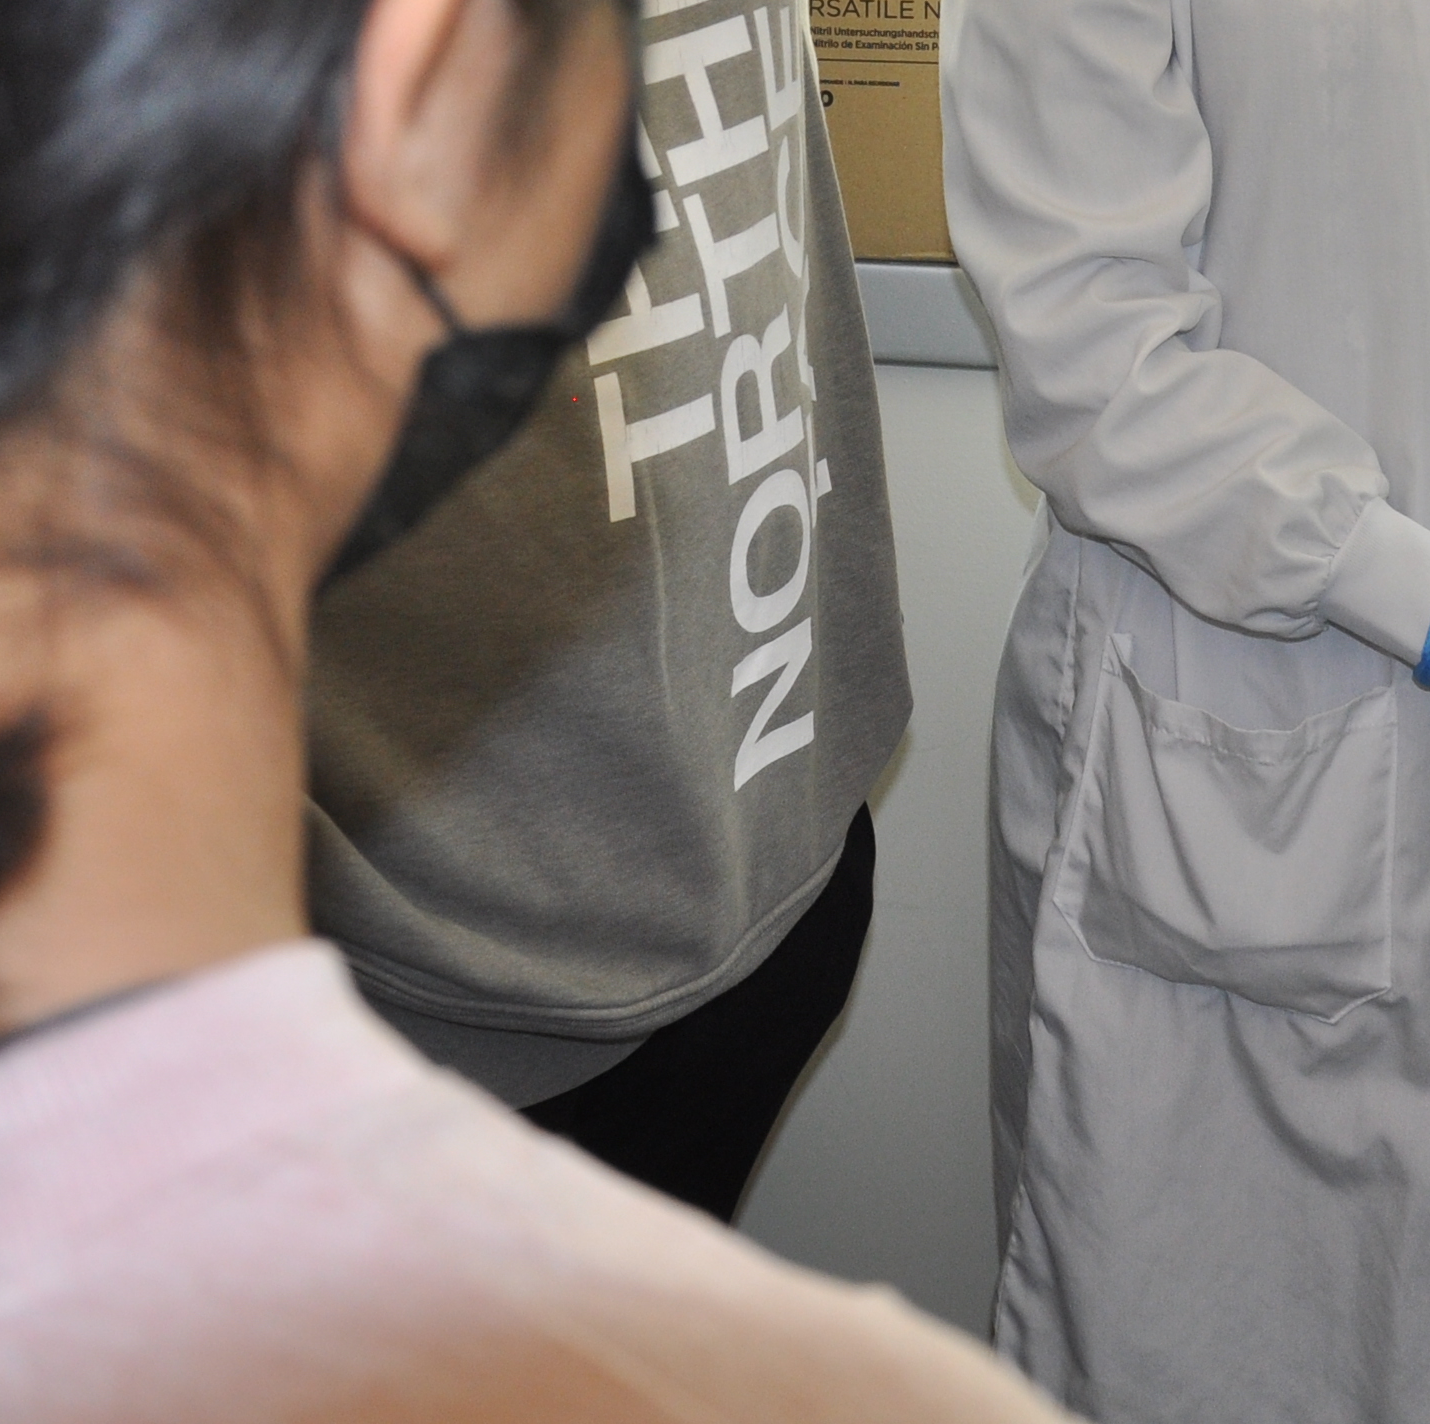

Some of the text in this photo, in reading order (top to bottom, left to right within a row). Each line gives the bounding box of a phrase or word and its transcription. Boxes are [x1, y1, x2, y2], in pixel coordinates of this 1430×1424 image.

[841, 40, 853, 49] de
[856, 40, 913, 51] Examinación
[915, 42, 929, 51] Sin
[643, 14, 815, 793] NORTH
